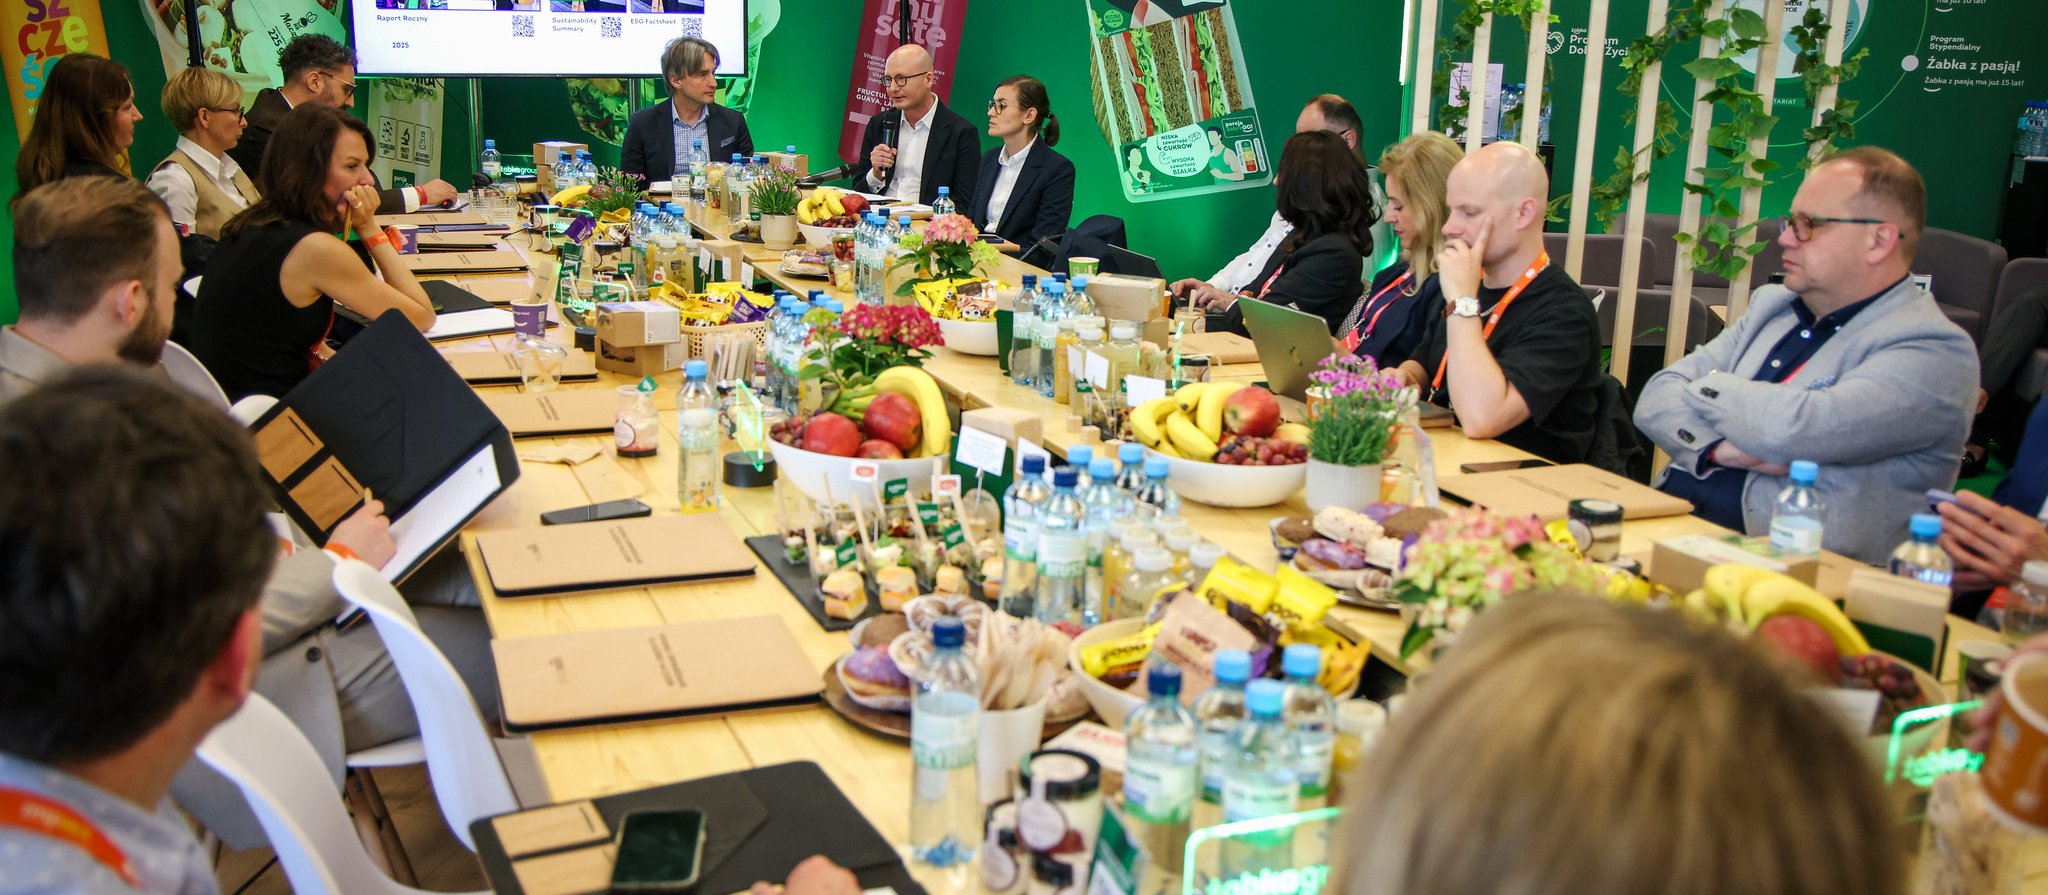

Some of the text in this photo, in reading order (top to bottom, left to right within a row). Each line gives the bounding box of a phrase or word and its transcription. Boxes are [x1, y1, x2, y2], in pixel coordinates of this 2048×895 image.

[552, 17, 597, 25] Sustainability
[268, 28, 283, 47] 225
[1930, 35, 1964, 44] Program
[1929, 43, 1981, 52] Stypendialny
[1927, 56, 2021, 74] Żabka z pasją!
[1924, 76, 1947, 84] Żabka
[1988, 79, 1999, 87] już
[857, 88, 887, 99] FRUCTUL
